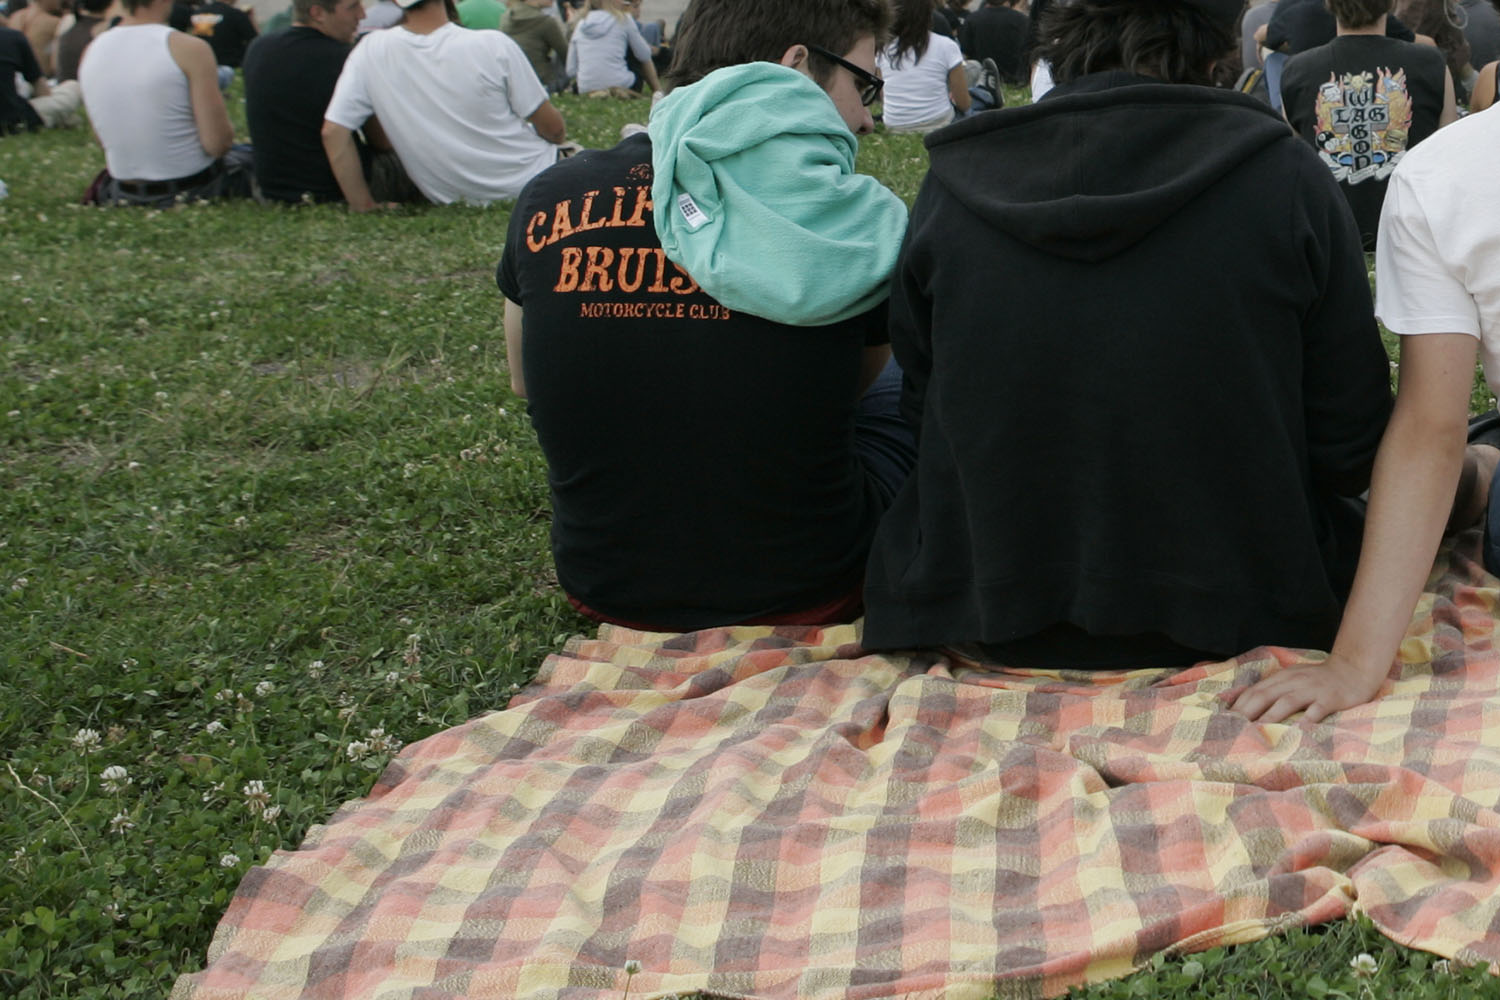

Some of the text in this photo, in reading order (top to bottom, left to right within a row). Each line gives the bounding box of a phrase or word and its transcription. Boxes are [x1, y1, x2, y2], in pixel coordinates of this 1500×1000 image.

[526, 185, 653, 252] CALIF
[553, 246, 704, 296] BRUIS
[580, 302, 731, 320] MOTORCYCLE CLUB
